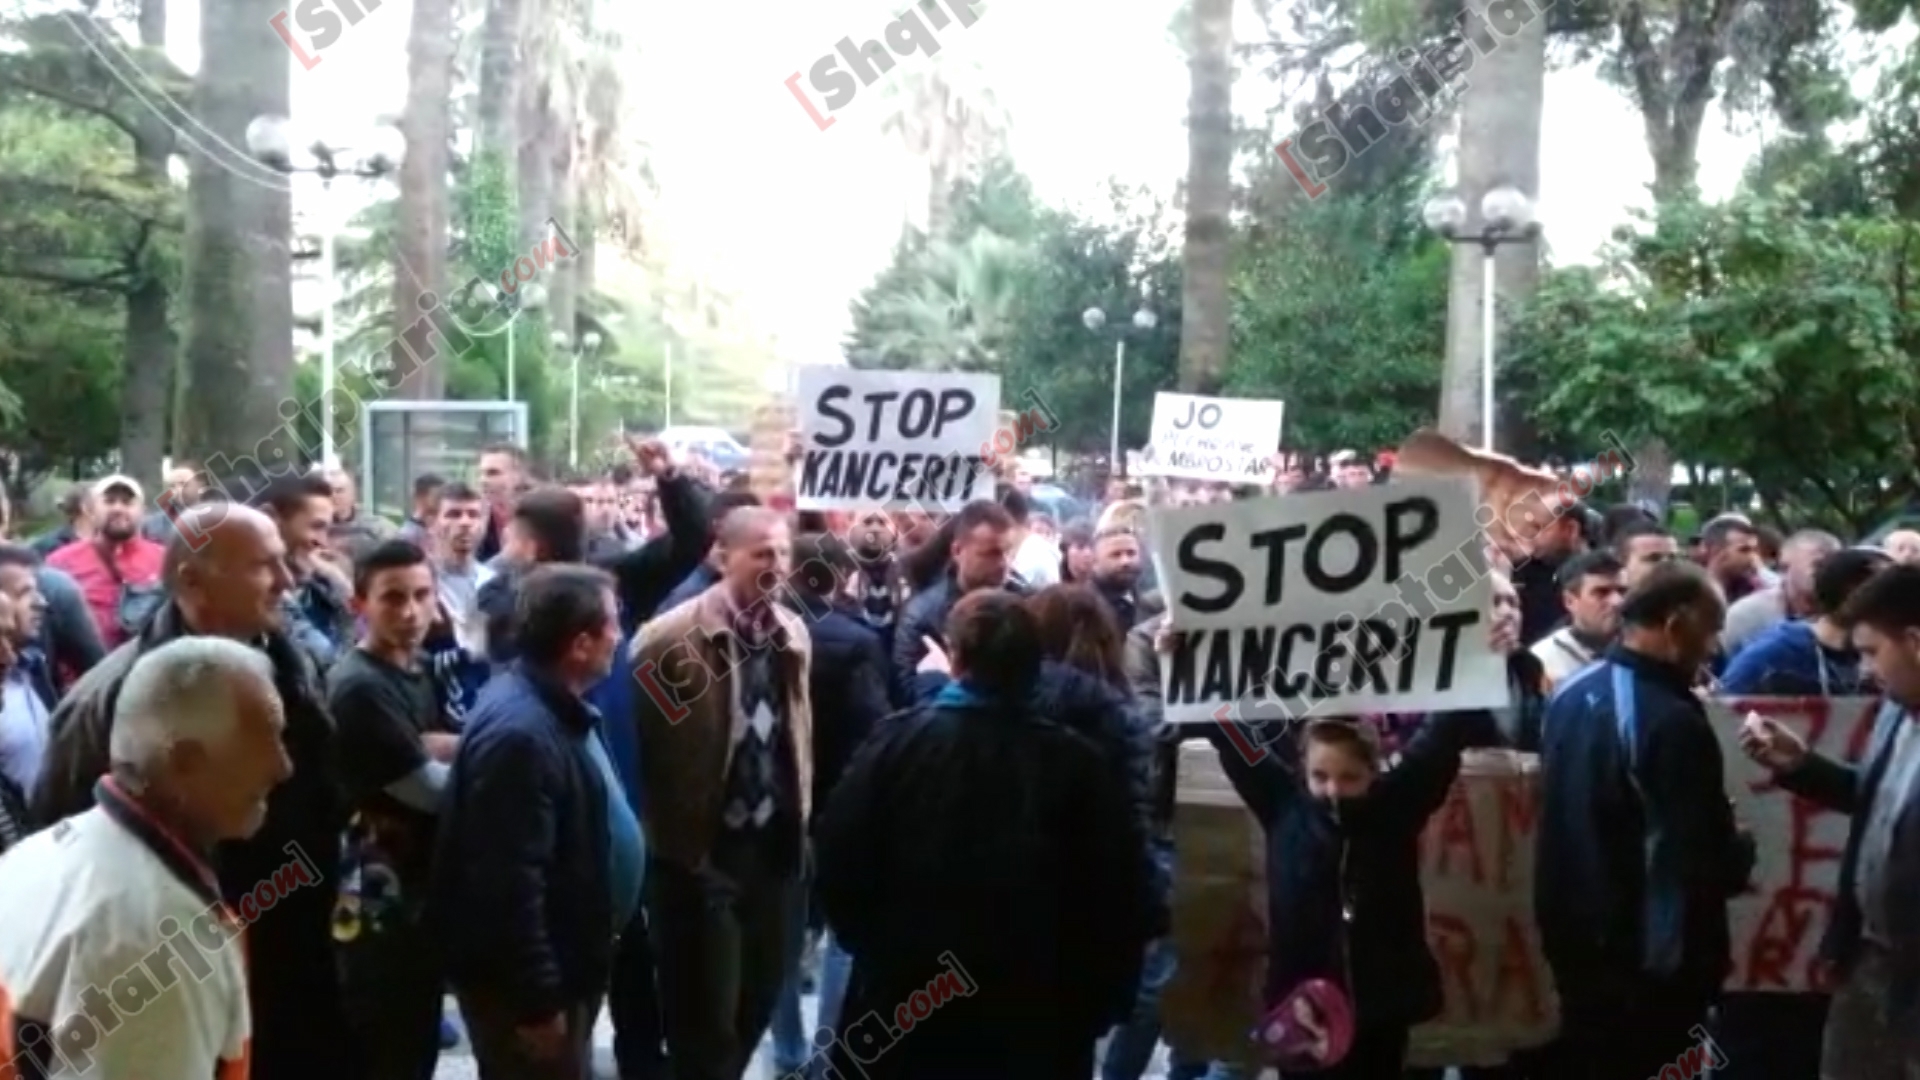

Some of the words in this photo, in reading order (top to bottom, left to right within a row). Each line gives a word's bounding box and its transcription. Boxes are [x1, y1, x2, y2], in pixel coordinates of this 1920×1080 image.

[813, 385, 976, 447] STOP
[1173, 400, 1223, 430] JO
[798, 449, 989, 500] KANCERIT
[1177, 496, 1439, 613] STOP
[1165, 610, 1481, 704] KANCERIT
